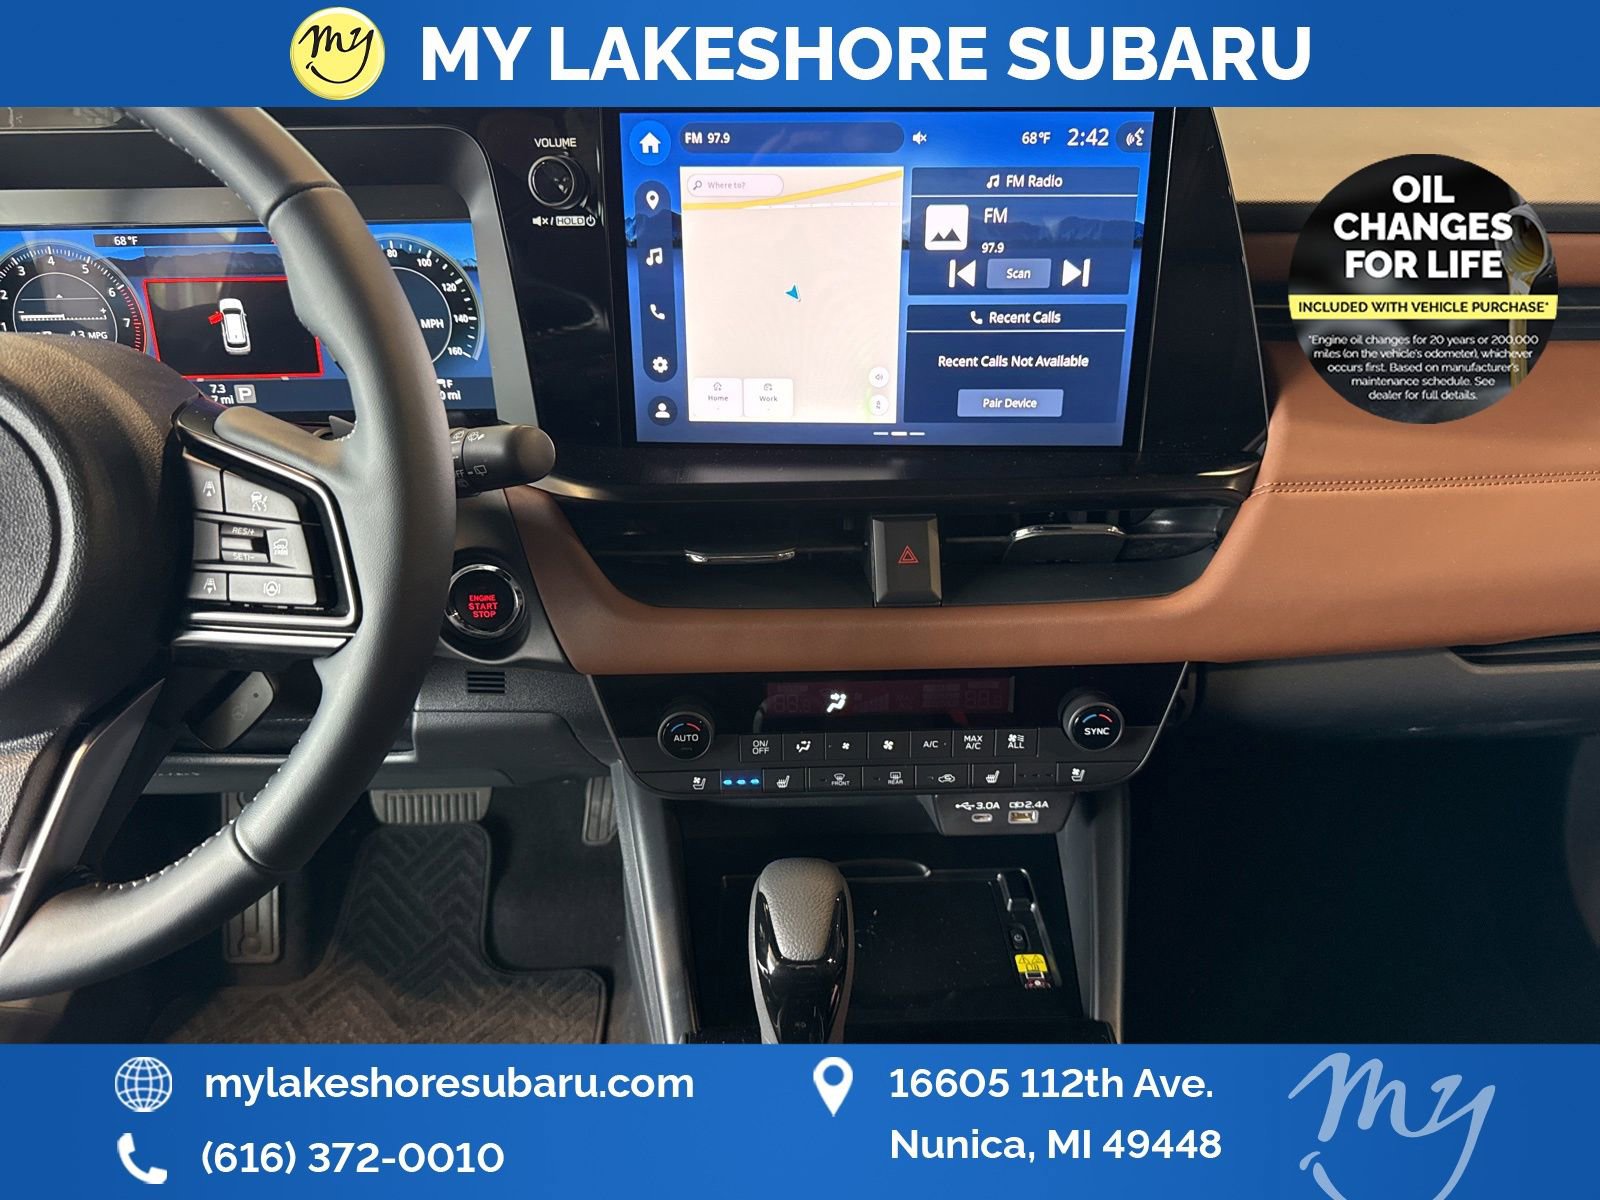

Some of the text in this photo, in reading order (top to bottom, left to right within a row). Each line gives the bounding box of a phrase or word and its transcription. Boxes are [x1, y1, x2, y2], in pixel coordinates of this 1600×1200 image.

[685, 132, 730, 143] FM 97.9
[1022, 131, 1051, 145] 68°F
[1067, 128, 1109, 146] 2:42
[534, 138, 577, 148] VOLUME
[731, 181, 746, 189] to?
[1006, 175, 1063, 187] FM Radio
[984, 208, 1008, 223] FM
[557, 216, 585, 226] HOLD
[113, 236, 138, 245] 68°F
[981, 242, 1004, 254] 97.9
[387, 249, 397, 258] 80
[48, 256, 55, 265] 4
[417, 259, 432, 267] 100
[18, 267, 26, 276] 3
[82, 265, 89, 274] 5
[1007, 269, 1030, 279] Scan
[442, 283, 456, 292] 120
[109, 288, 116, 297] 6
[453, 314, 469, 323] 140
[989, 312, 1061, 323] Recent Calls
[123, 318, 130, 327] 7
[420, 319, 444, 328] MPH
[88, 331, 108, 339] MPG
[448, 347, 463, 355] 160
[938, 355, 1089, 367] Recent Calls Not Available
[238, 388, 252, 401] P
[447, 390, 461, 400] mi
[220, 395, 234, 404] mi
[983, 398, 1037, 408] Pair Device
[673, 734, 699, 742] AUTO
[752, 747, 769, 755] OFF
